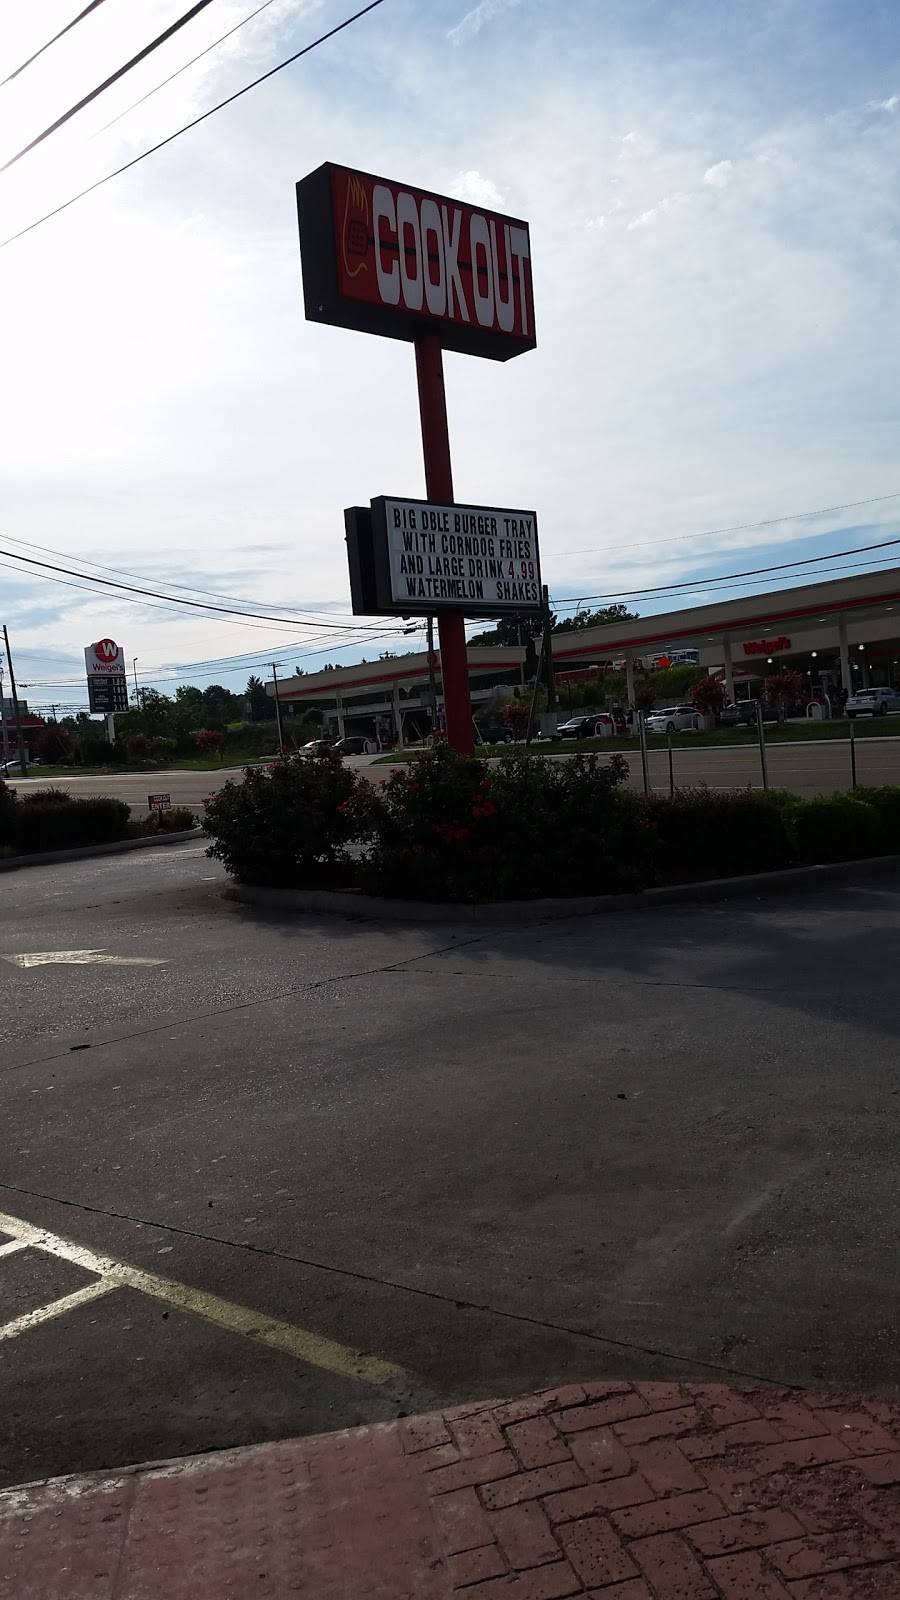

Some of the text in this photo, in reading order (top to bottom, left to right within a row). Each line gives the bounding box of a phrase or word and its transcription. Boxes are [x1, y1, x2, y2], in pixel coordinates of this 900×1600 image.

[372, 185, 529, 335] COOK OUT
[393, 508, 532, 538] BIG DBLE BURGER TRAY
[402, 532, 531, 559] WITH CORNDOG FRIES
[400, 554, 535, 580] AND LARGE DRINK 4.99
[406, 577, 538, 601] WATERMELON SHAKES
[102, 642, 117, 657] W
[92, 663, 124, 673] Weigel's
